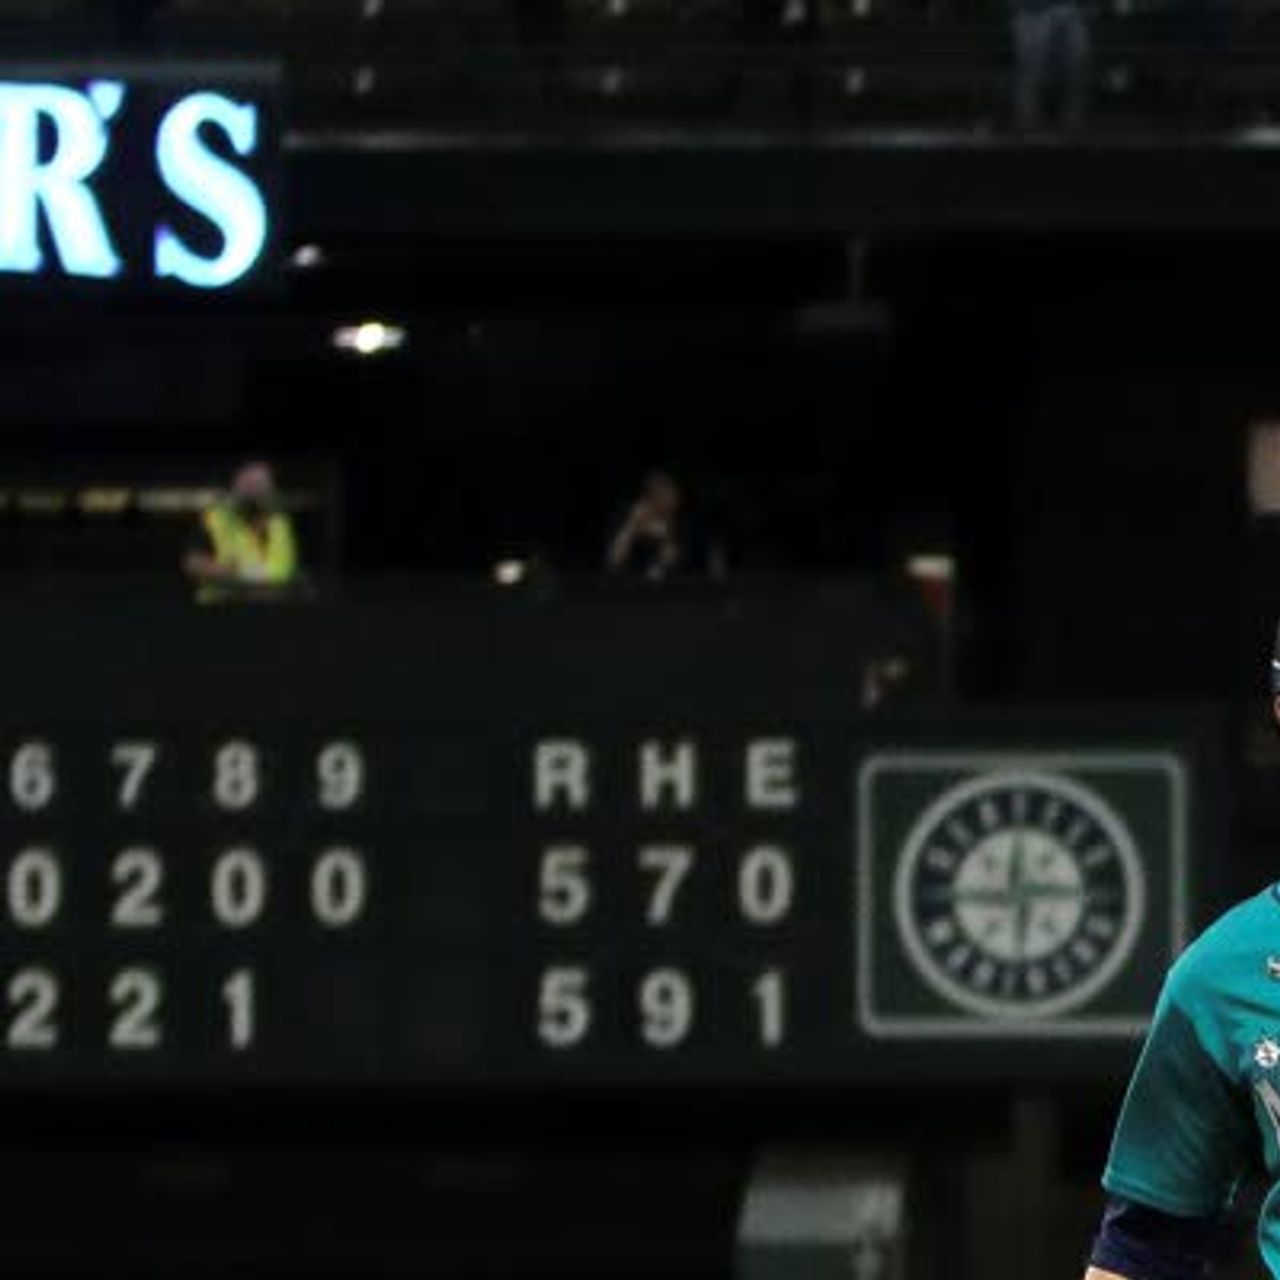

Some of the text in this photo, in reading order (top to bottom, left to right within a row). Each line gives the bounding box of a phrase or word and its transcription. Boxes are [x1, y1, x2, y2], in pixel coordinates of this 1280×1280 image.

[10, 740, 797, 809] 6 7 8 9 R H E
[7, 846, 794, 927] 0 2 0 0 5 7 0
[7, 967, 785, 1049] 2 2 1 5 9 1
